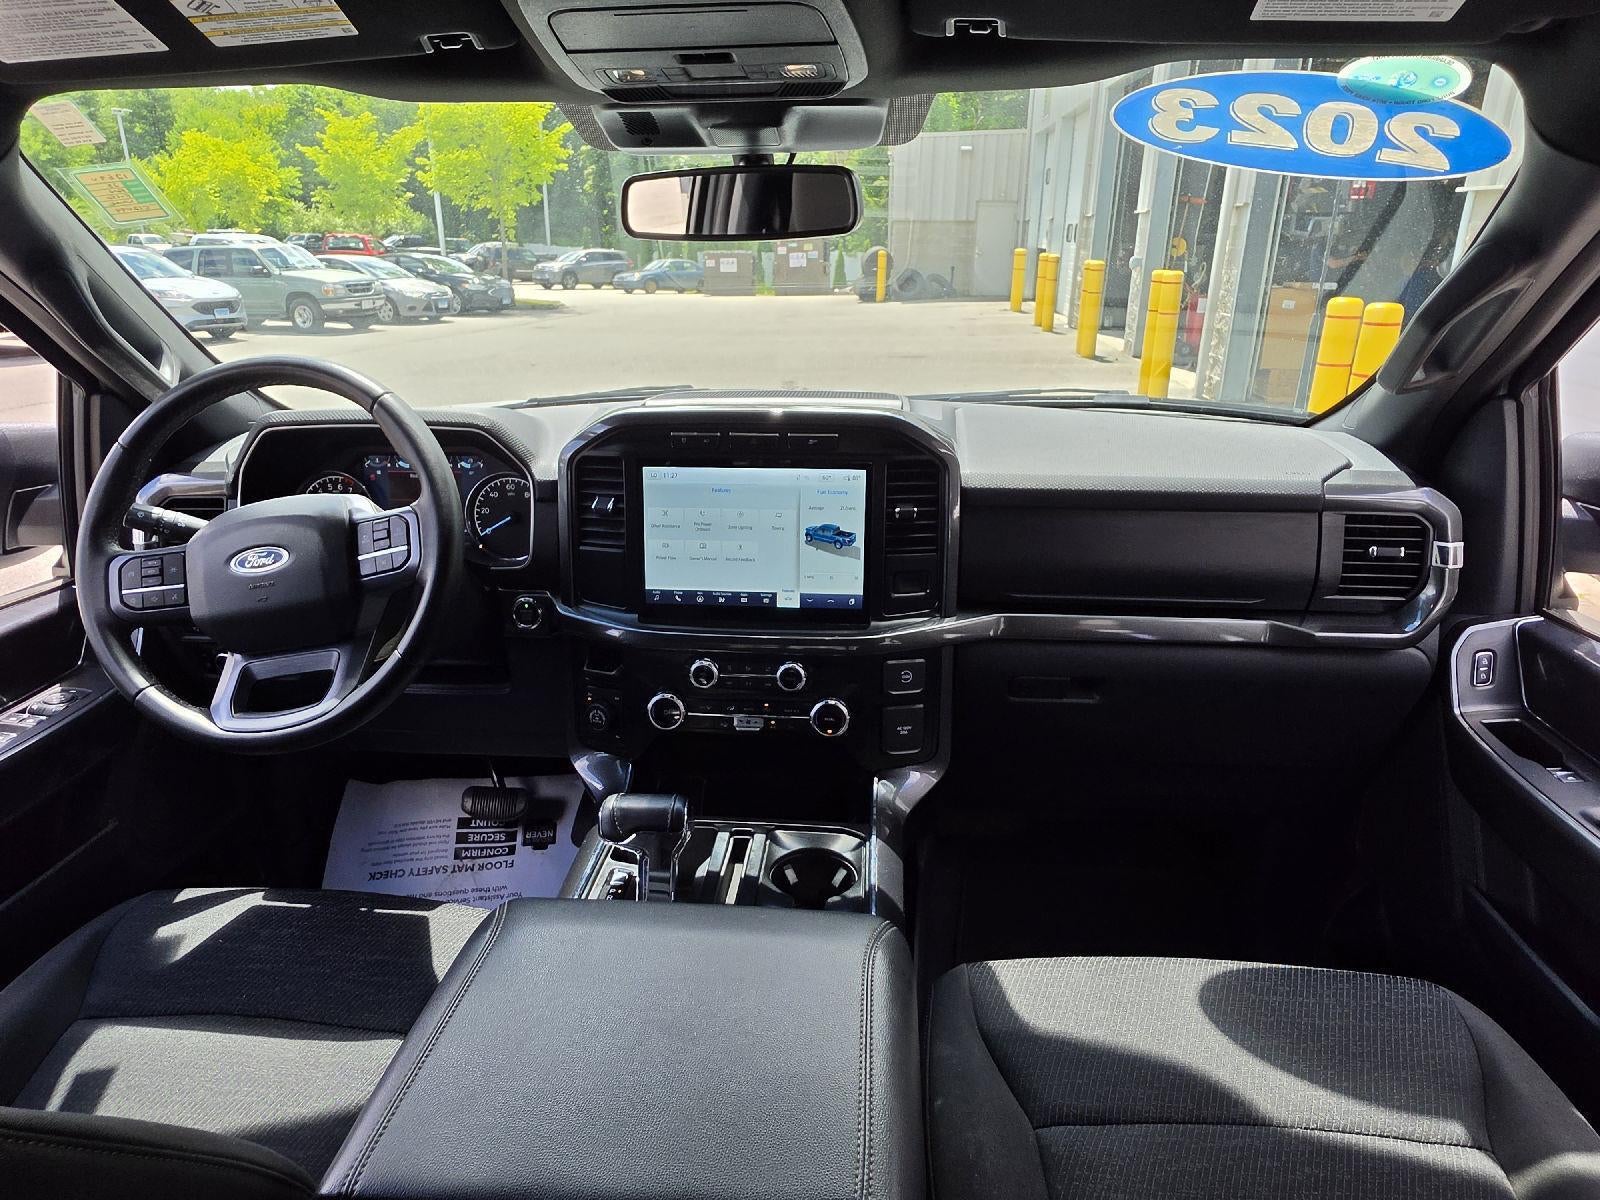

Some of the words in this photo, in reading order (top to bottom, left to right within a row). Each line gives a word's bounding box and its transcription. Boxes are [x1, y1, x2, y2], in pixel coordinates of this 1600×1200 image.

[327, 483, 333, 491] 5
[337, 483, 343, 491] 6
[245, 551, 275, 568] Ford
[467, 832, 506, 842] SECURE
[525, 829, 554, 840] NEVER
[461, 847, 509, 858] CONFIRM
[450, 863, 475, 874] MAT
[478, 859, 515, 872] FLOOR
[367, 868, 406, 882] CHECK
[408, 864, 449, 878] SAFETY
[434, 888, 470, 898] questions
[471, 886, 491, 895] these
[492, 884, 508, 893] with
[473, 893, 505, 903] Assistant
[506, 891, 522, 900] Your
